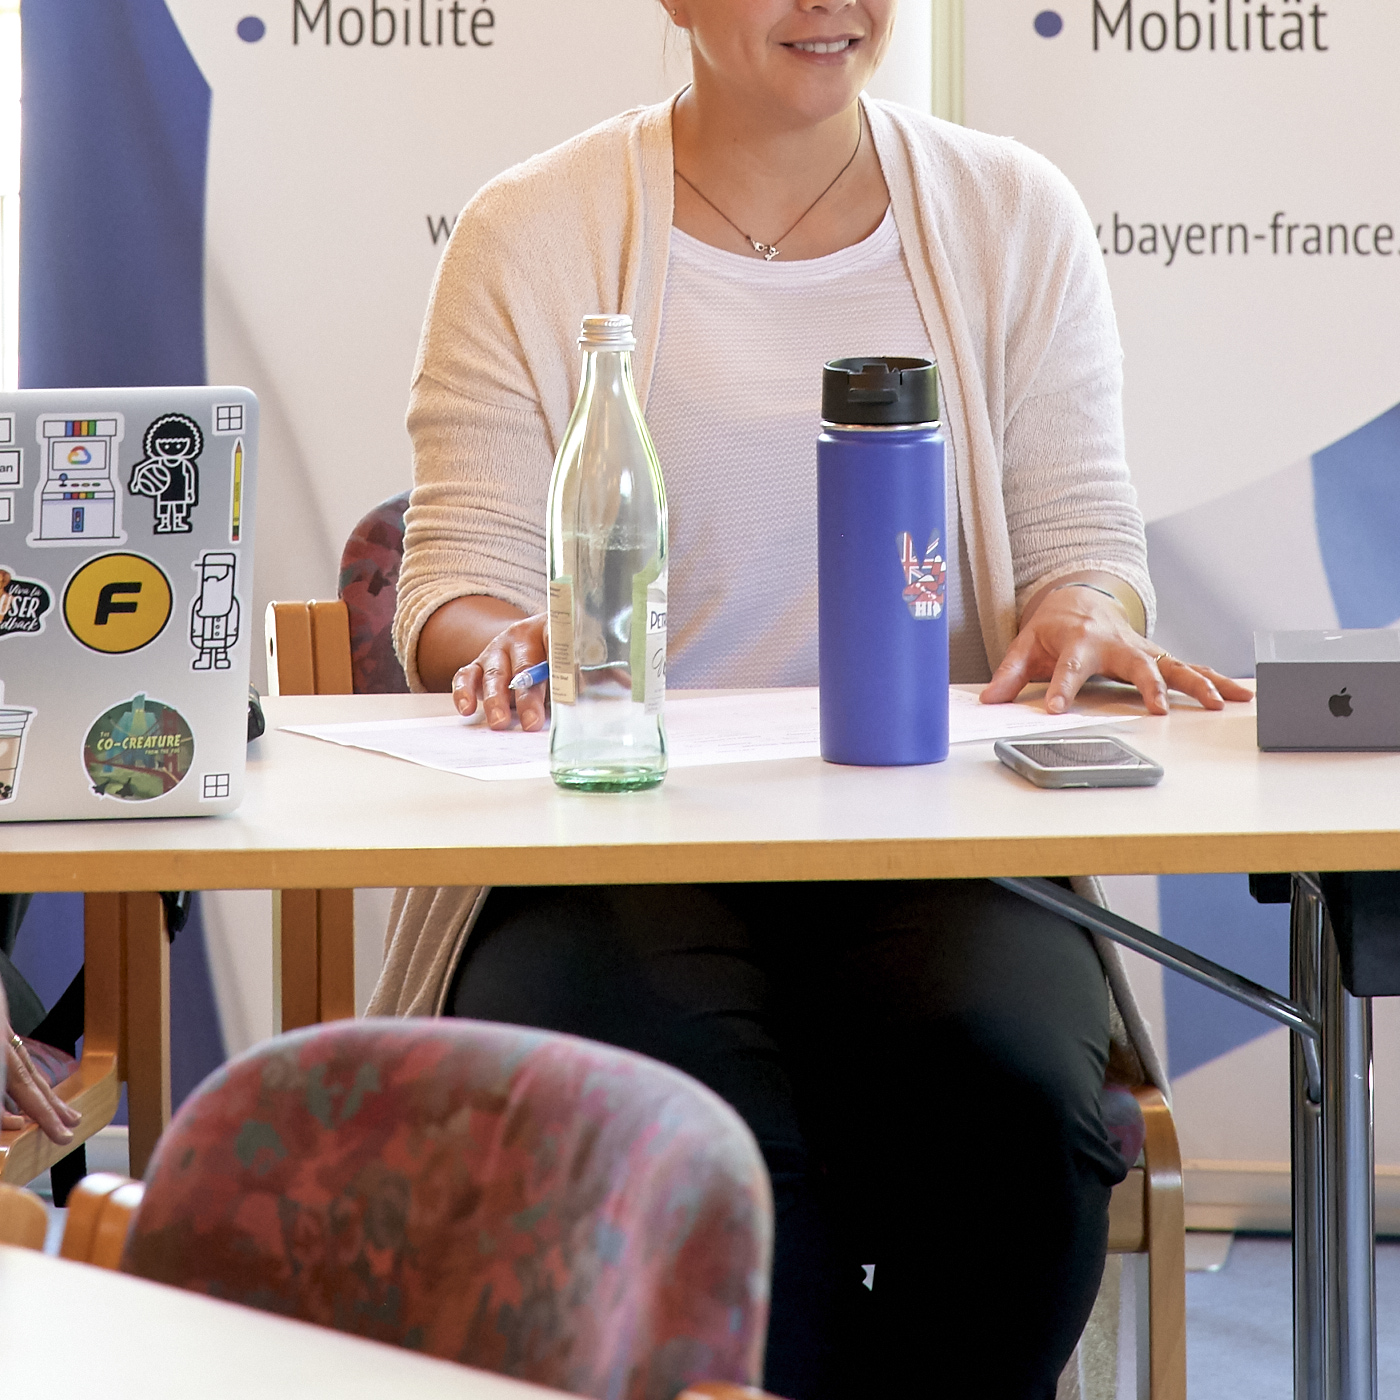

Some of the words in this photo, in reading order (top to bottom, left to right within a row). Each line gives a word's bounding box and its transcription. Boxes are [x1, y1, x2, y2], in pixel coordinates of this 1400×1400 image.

[8, 584, 29, 596] Viva
[30, 586, 43, 596] la
[94, 581, 143, 626] F
[97, 734, 182, 751] CO-CREATURE
